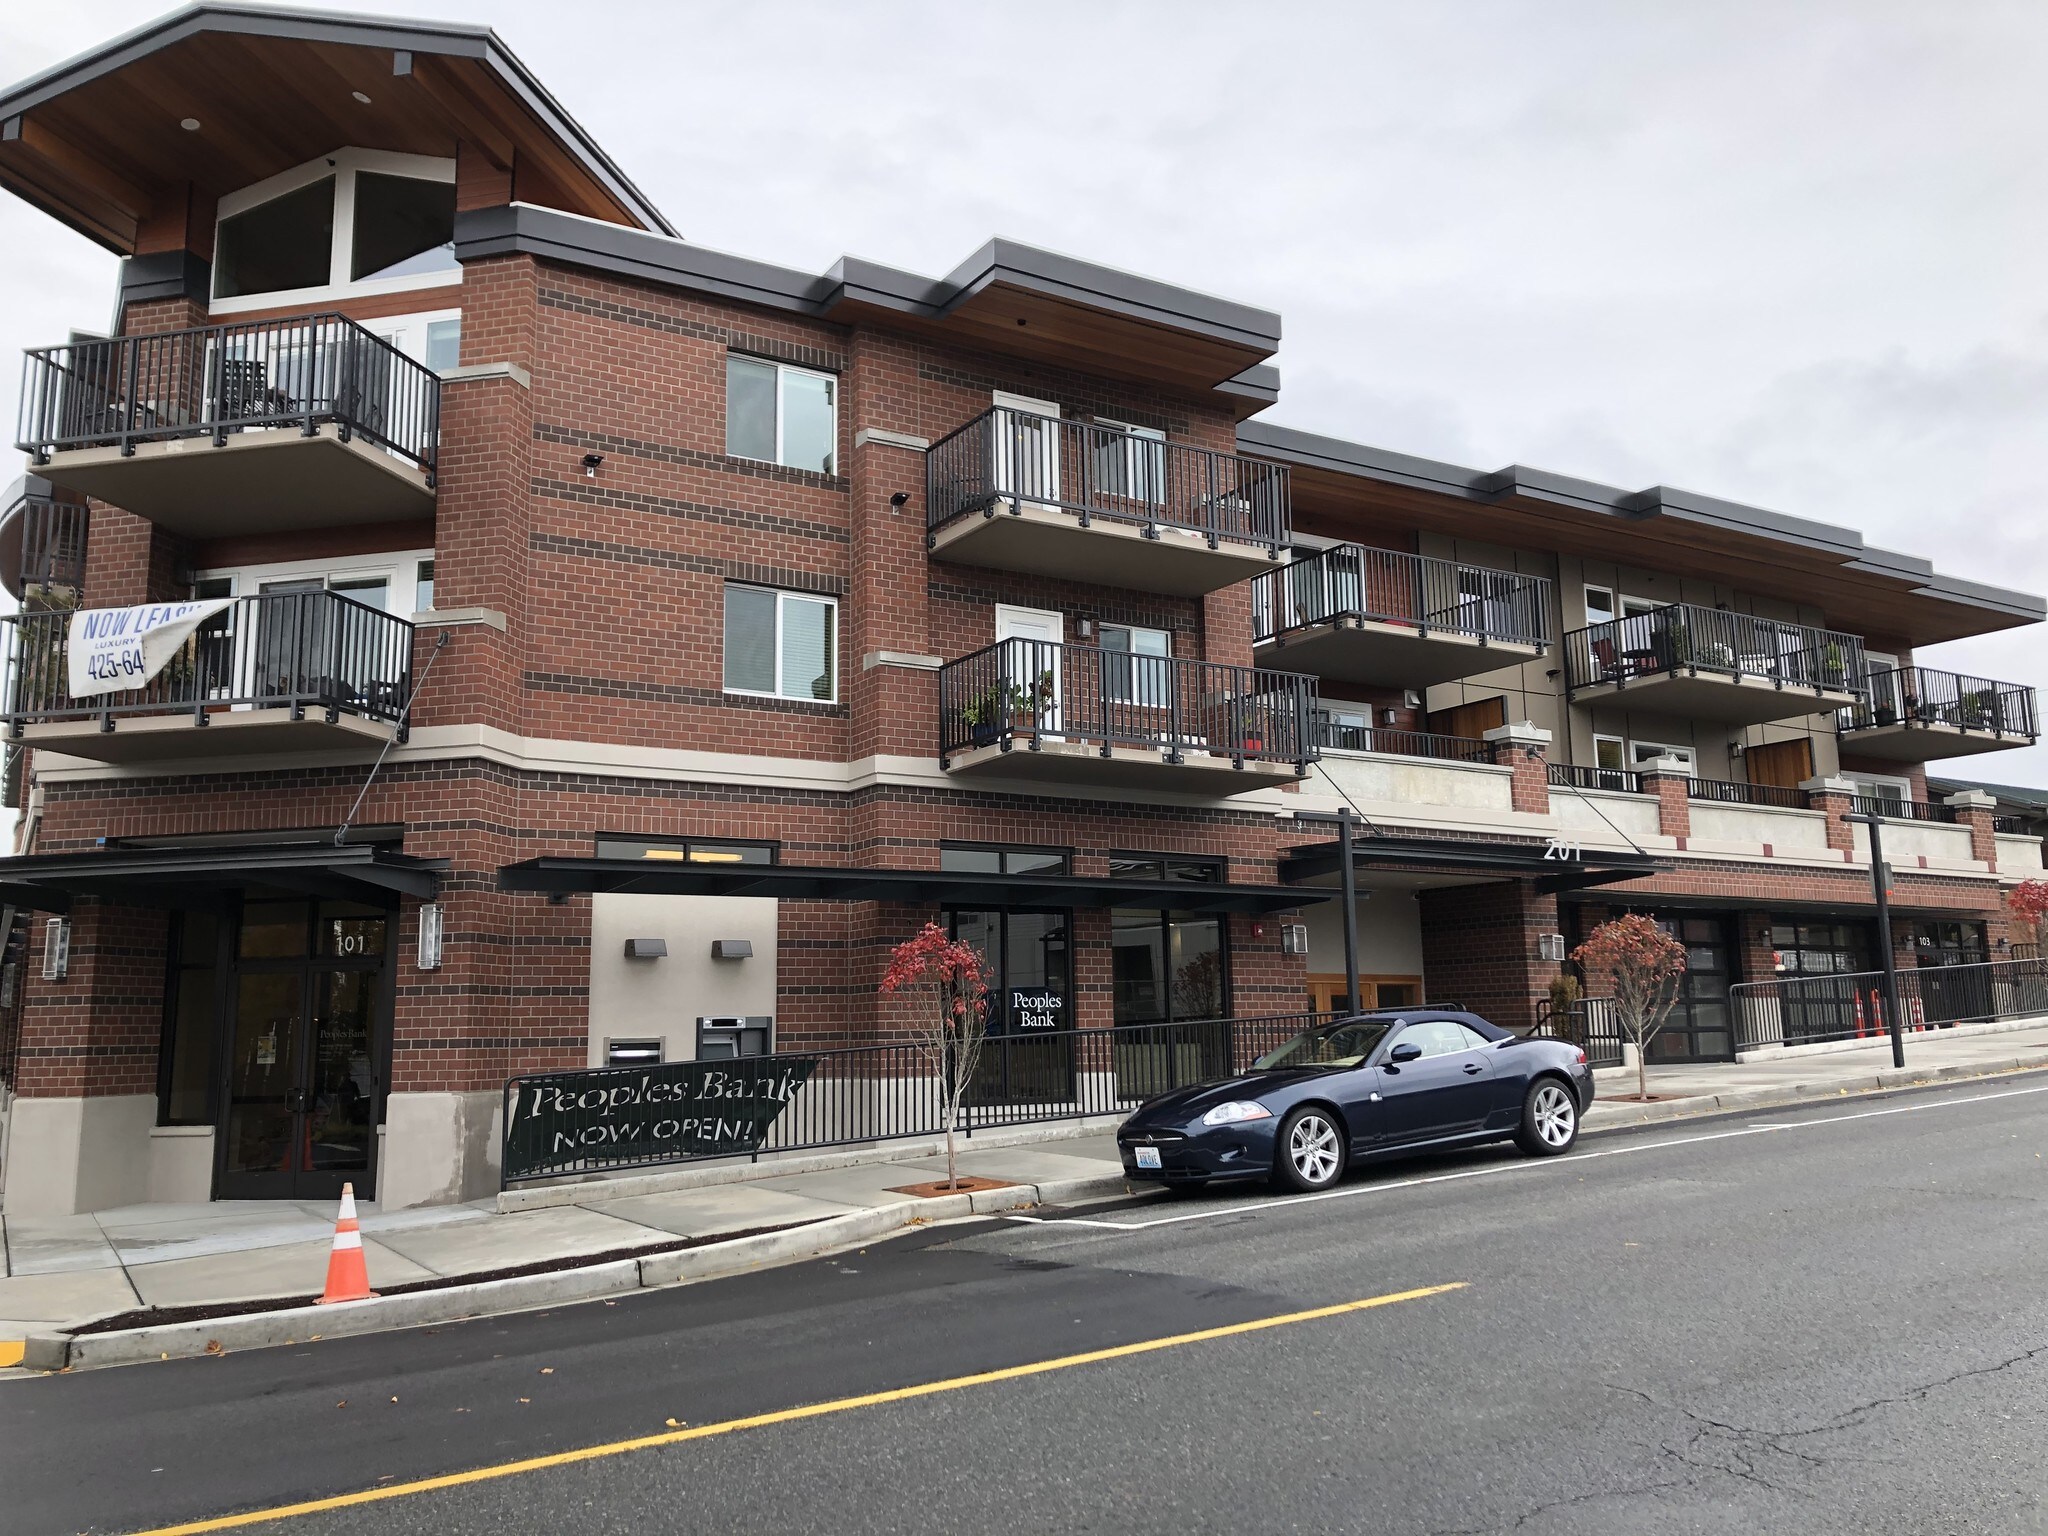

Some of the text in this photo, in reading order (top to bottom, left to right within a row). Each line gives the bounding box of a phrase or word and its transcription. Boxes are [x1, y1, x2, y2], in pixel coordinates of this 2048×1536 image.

[83, 611, 133, 640] NOW
[94, 637, 136, 650] LUXURY
[1543, 838, 1580, 862] 201
[336, 935, 364, 956] 101
[1919, 936, 1931, 946] 103
[1012, 991, 1062, 1013] Peoples
[1020, 1010, 1056, 1027] Bank
[524, 1067, 806, 1120] Peoples Bank
[553, 1117, 754, 1153] NOW OPEN!
